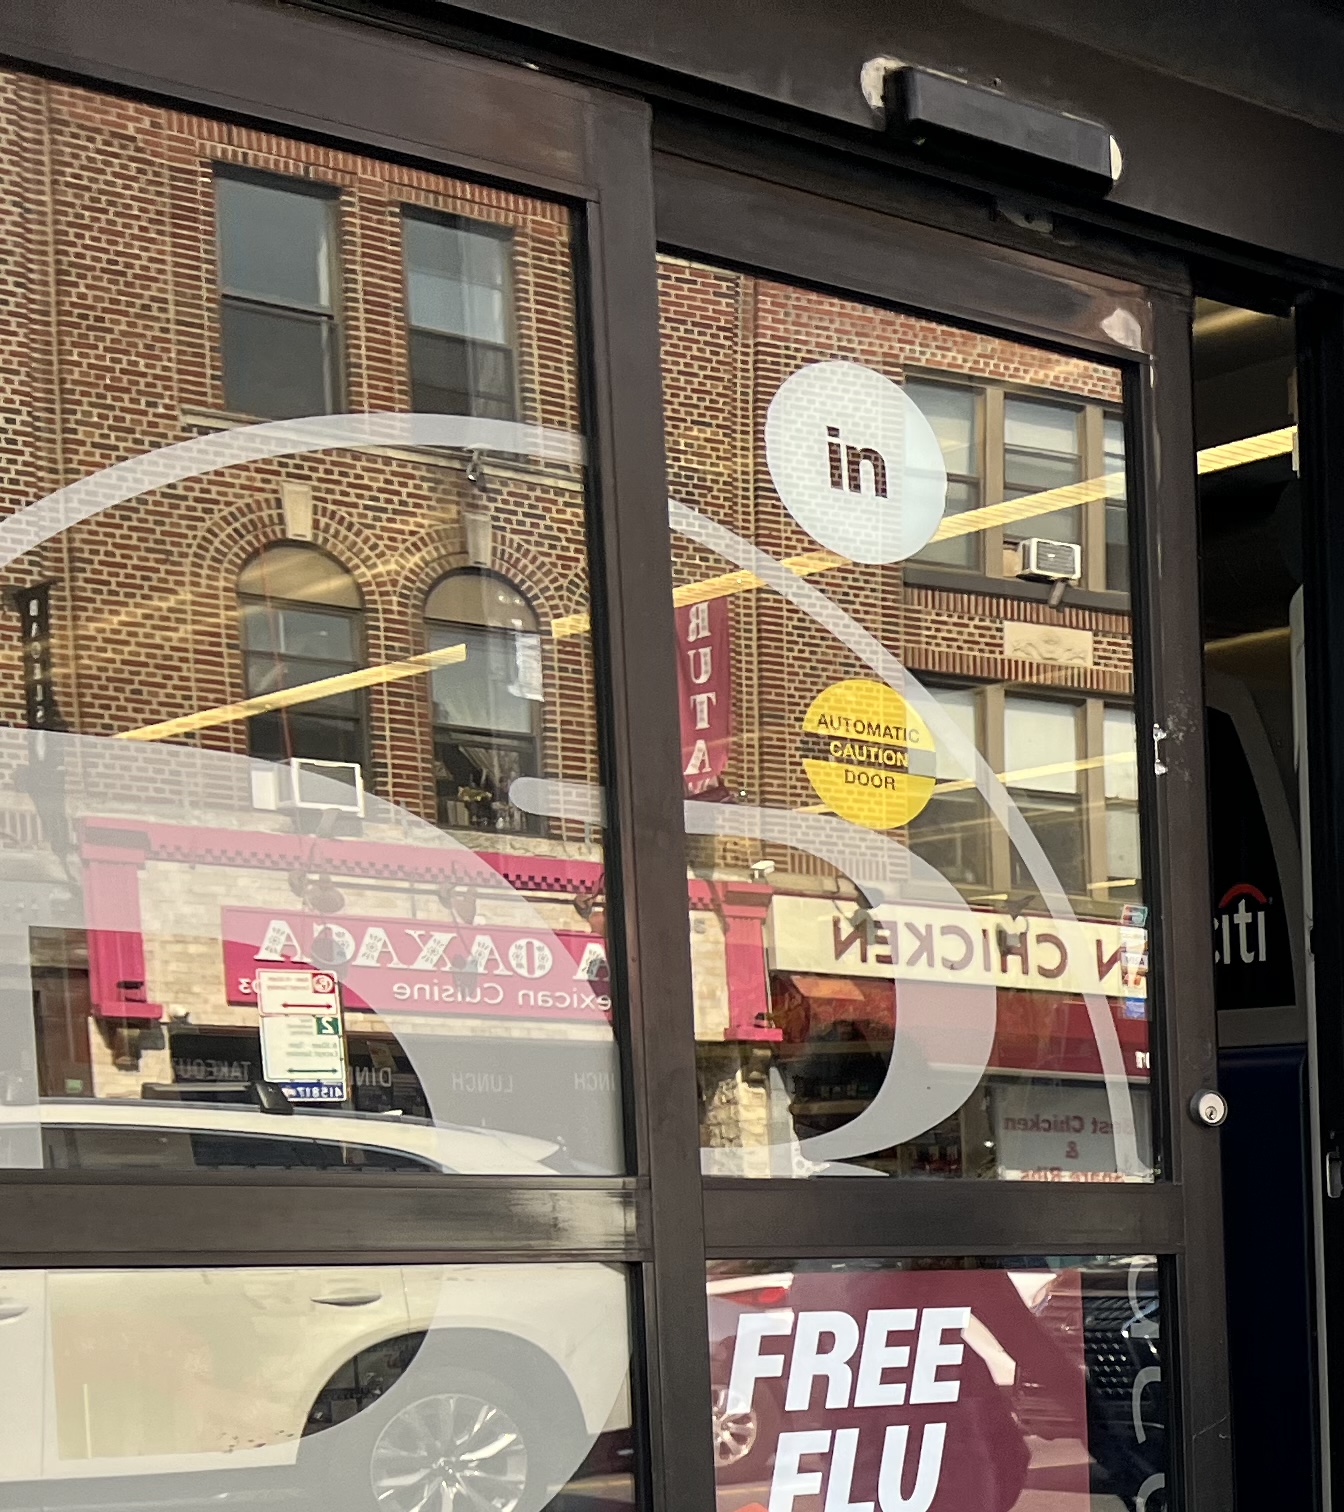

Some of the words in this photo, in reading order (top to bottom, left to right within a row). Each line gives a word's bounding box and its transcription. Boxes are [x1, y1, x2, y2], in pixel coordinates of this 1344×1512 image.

[825, 426, 888, 498] in
[817, 712, 920, 744] AUTOMATIC
[829, 740, 909, 768] CAUTION
[844, 769, 896, 791] DOOR
[1213, 898, 1267, 965] iti
[726, 1306, 972, 1415] FREE
